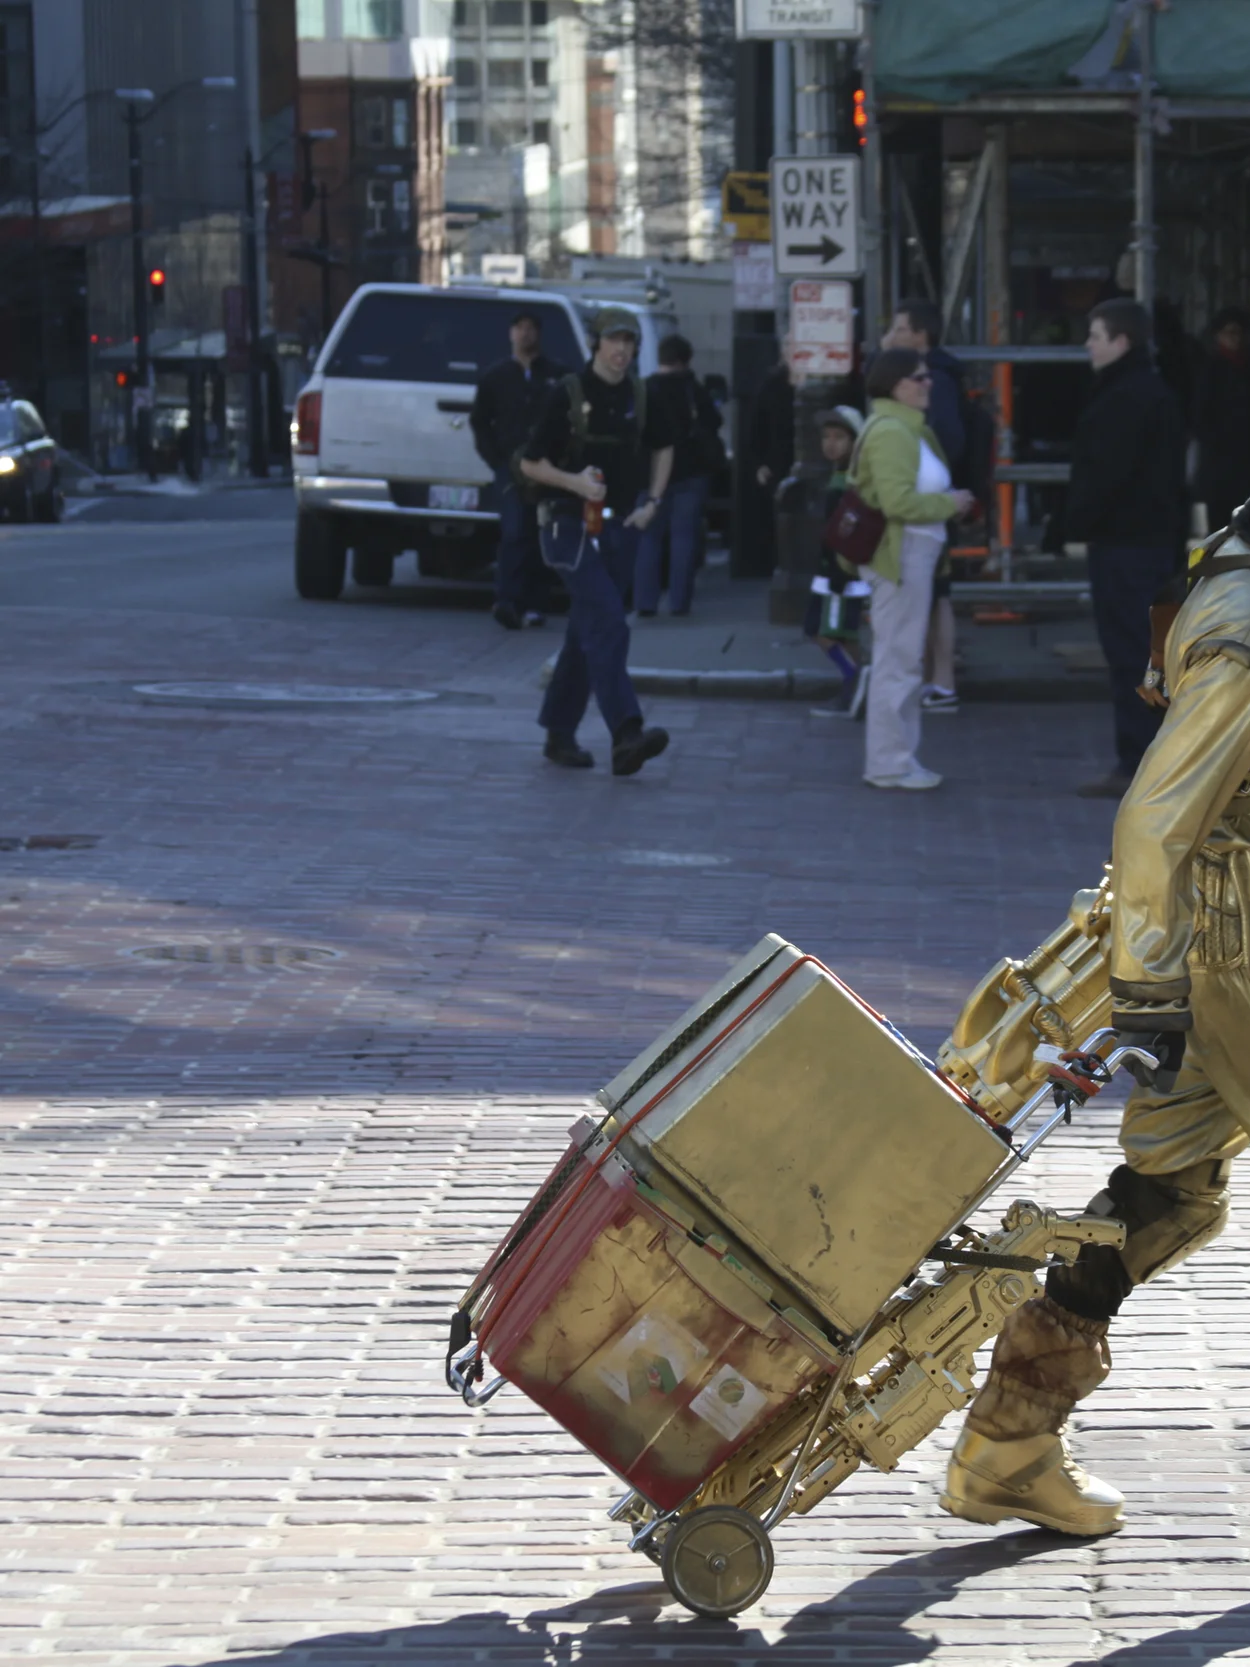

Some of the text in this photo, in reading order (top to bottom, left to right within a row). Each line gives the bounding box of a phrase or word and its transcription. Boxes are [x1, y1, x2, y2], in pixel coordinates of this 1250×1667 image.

[768, 8, 833, 23] TRANSIT
[782, 167, 847, 196] ONE
[782, 202, 849, 229] WAY
